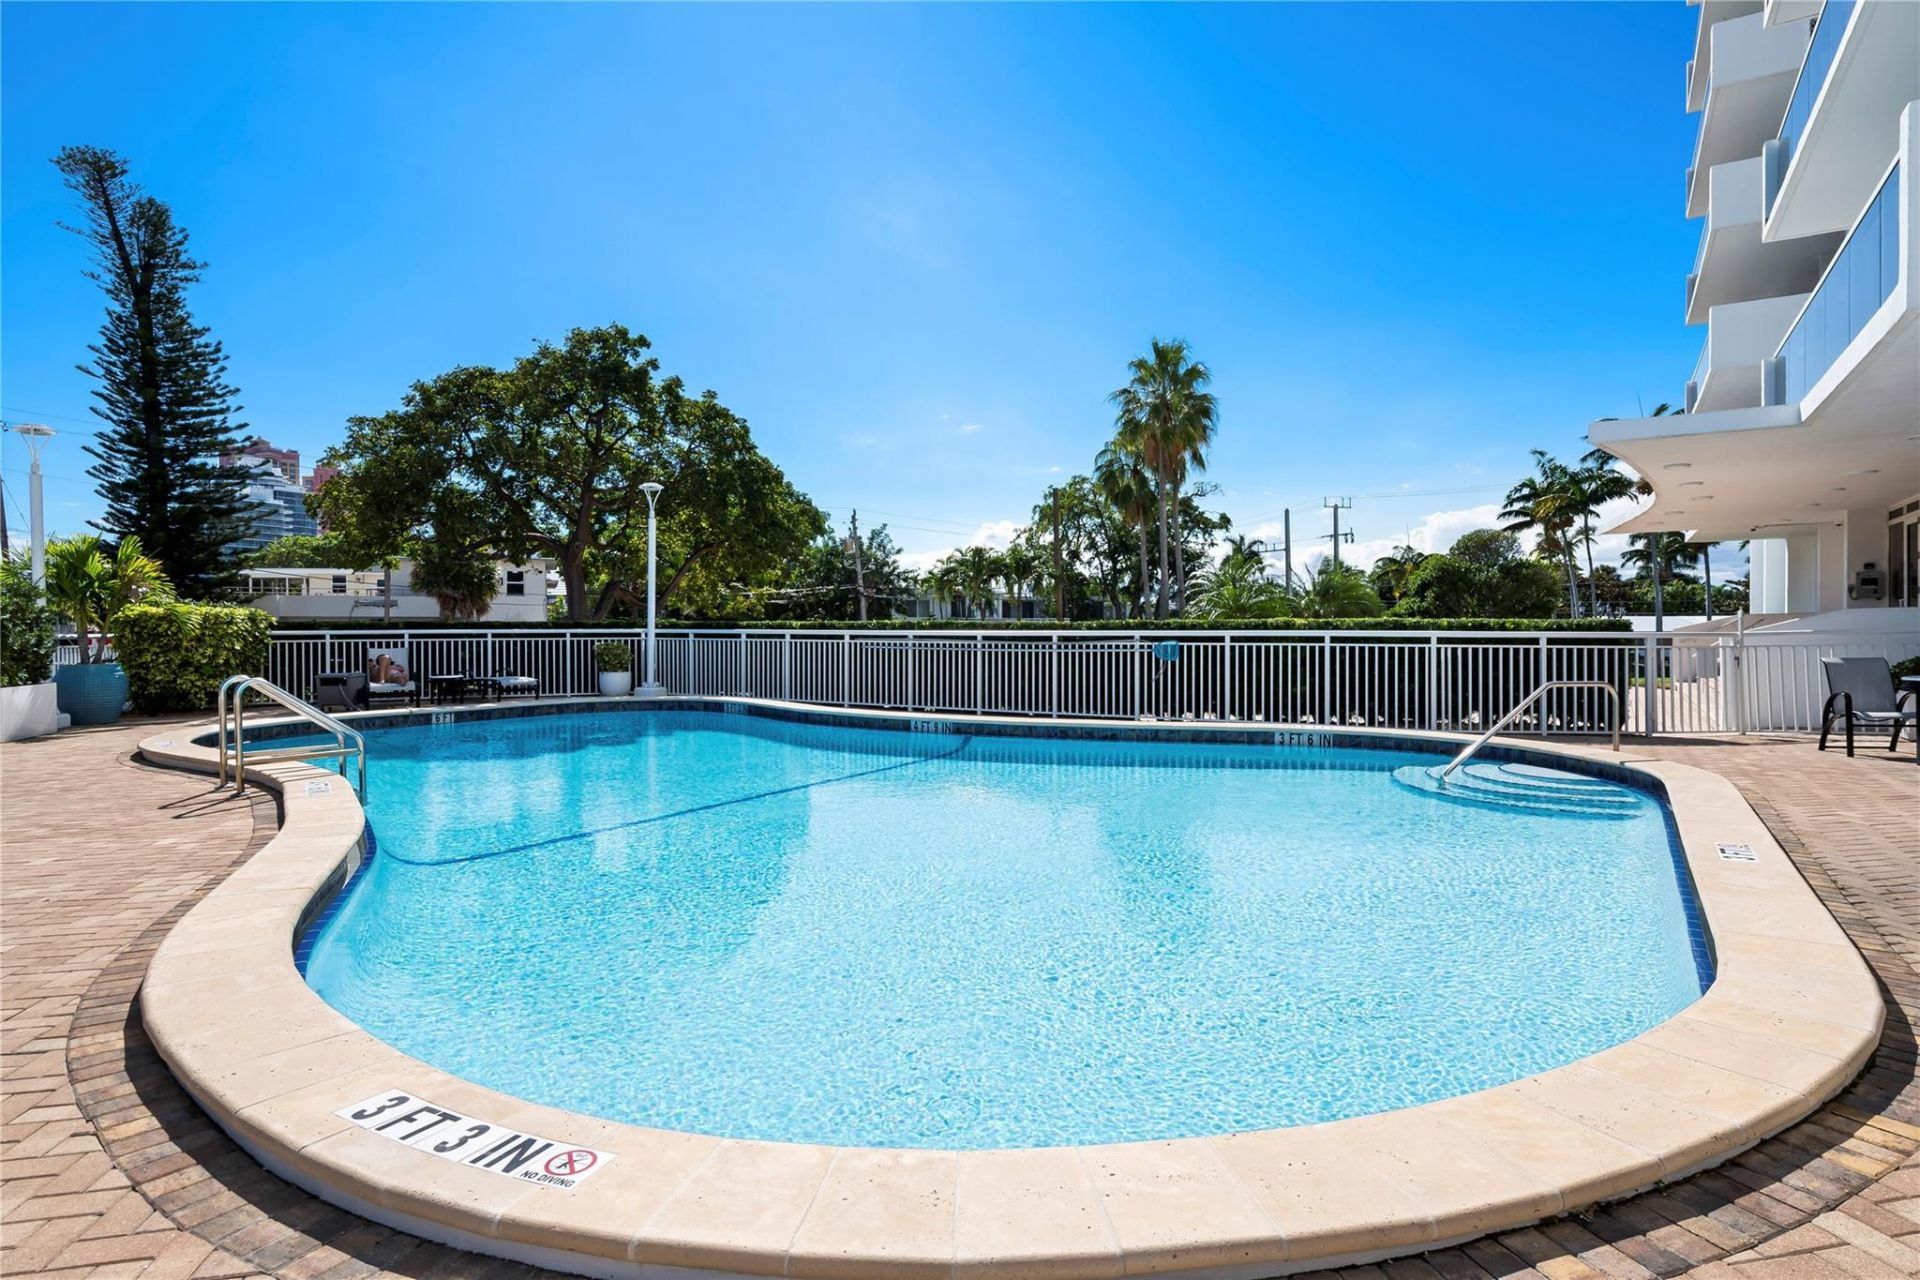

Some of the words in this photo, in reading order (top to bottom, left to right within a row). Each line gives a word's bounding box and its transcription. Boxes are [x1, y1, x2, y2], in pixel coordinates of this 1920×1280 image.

[921, 721, 931, 733] FT
[942, 721, 952, 734] IN
[1278, 732, 1285, 745] 3
[1289, 733, 1303, 746] FT
[1307, 733, 1314, 746] 6
[1319, 734, 1332, 747] IN
[351, 1095, 410, 1120] 3
[374, 1105, 462, 1141] FT
[433, 1124, 491, 1153] 3
[468, 1134, 554, 1174] IN
[519, 1170, 539, 1179] NO
[536, 1174, 576, 1188] DIVING
